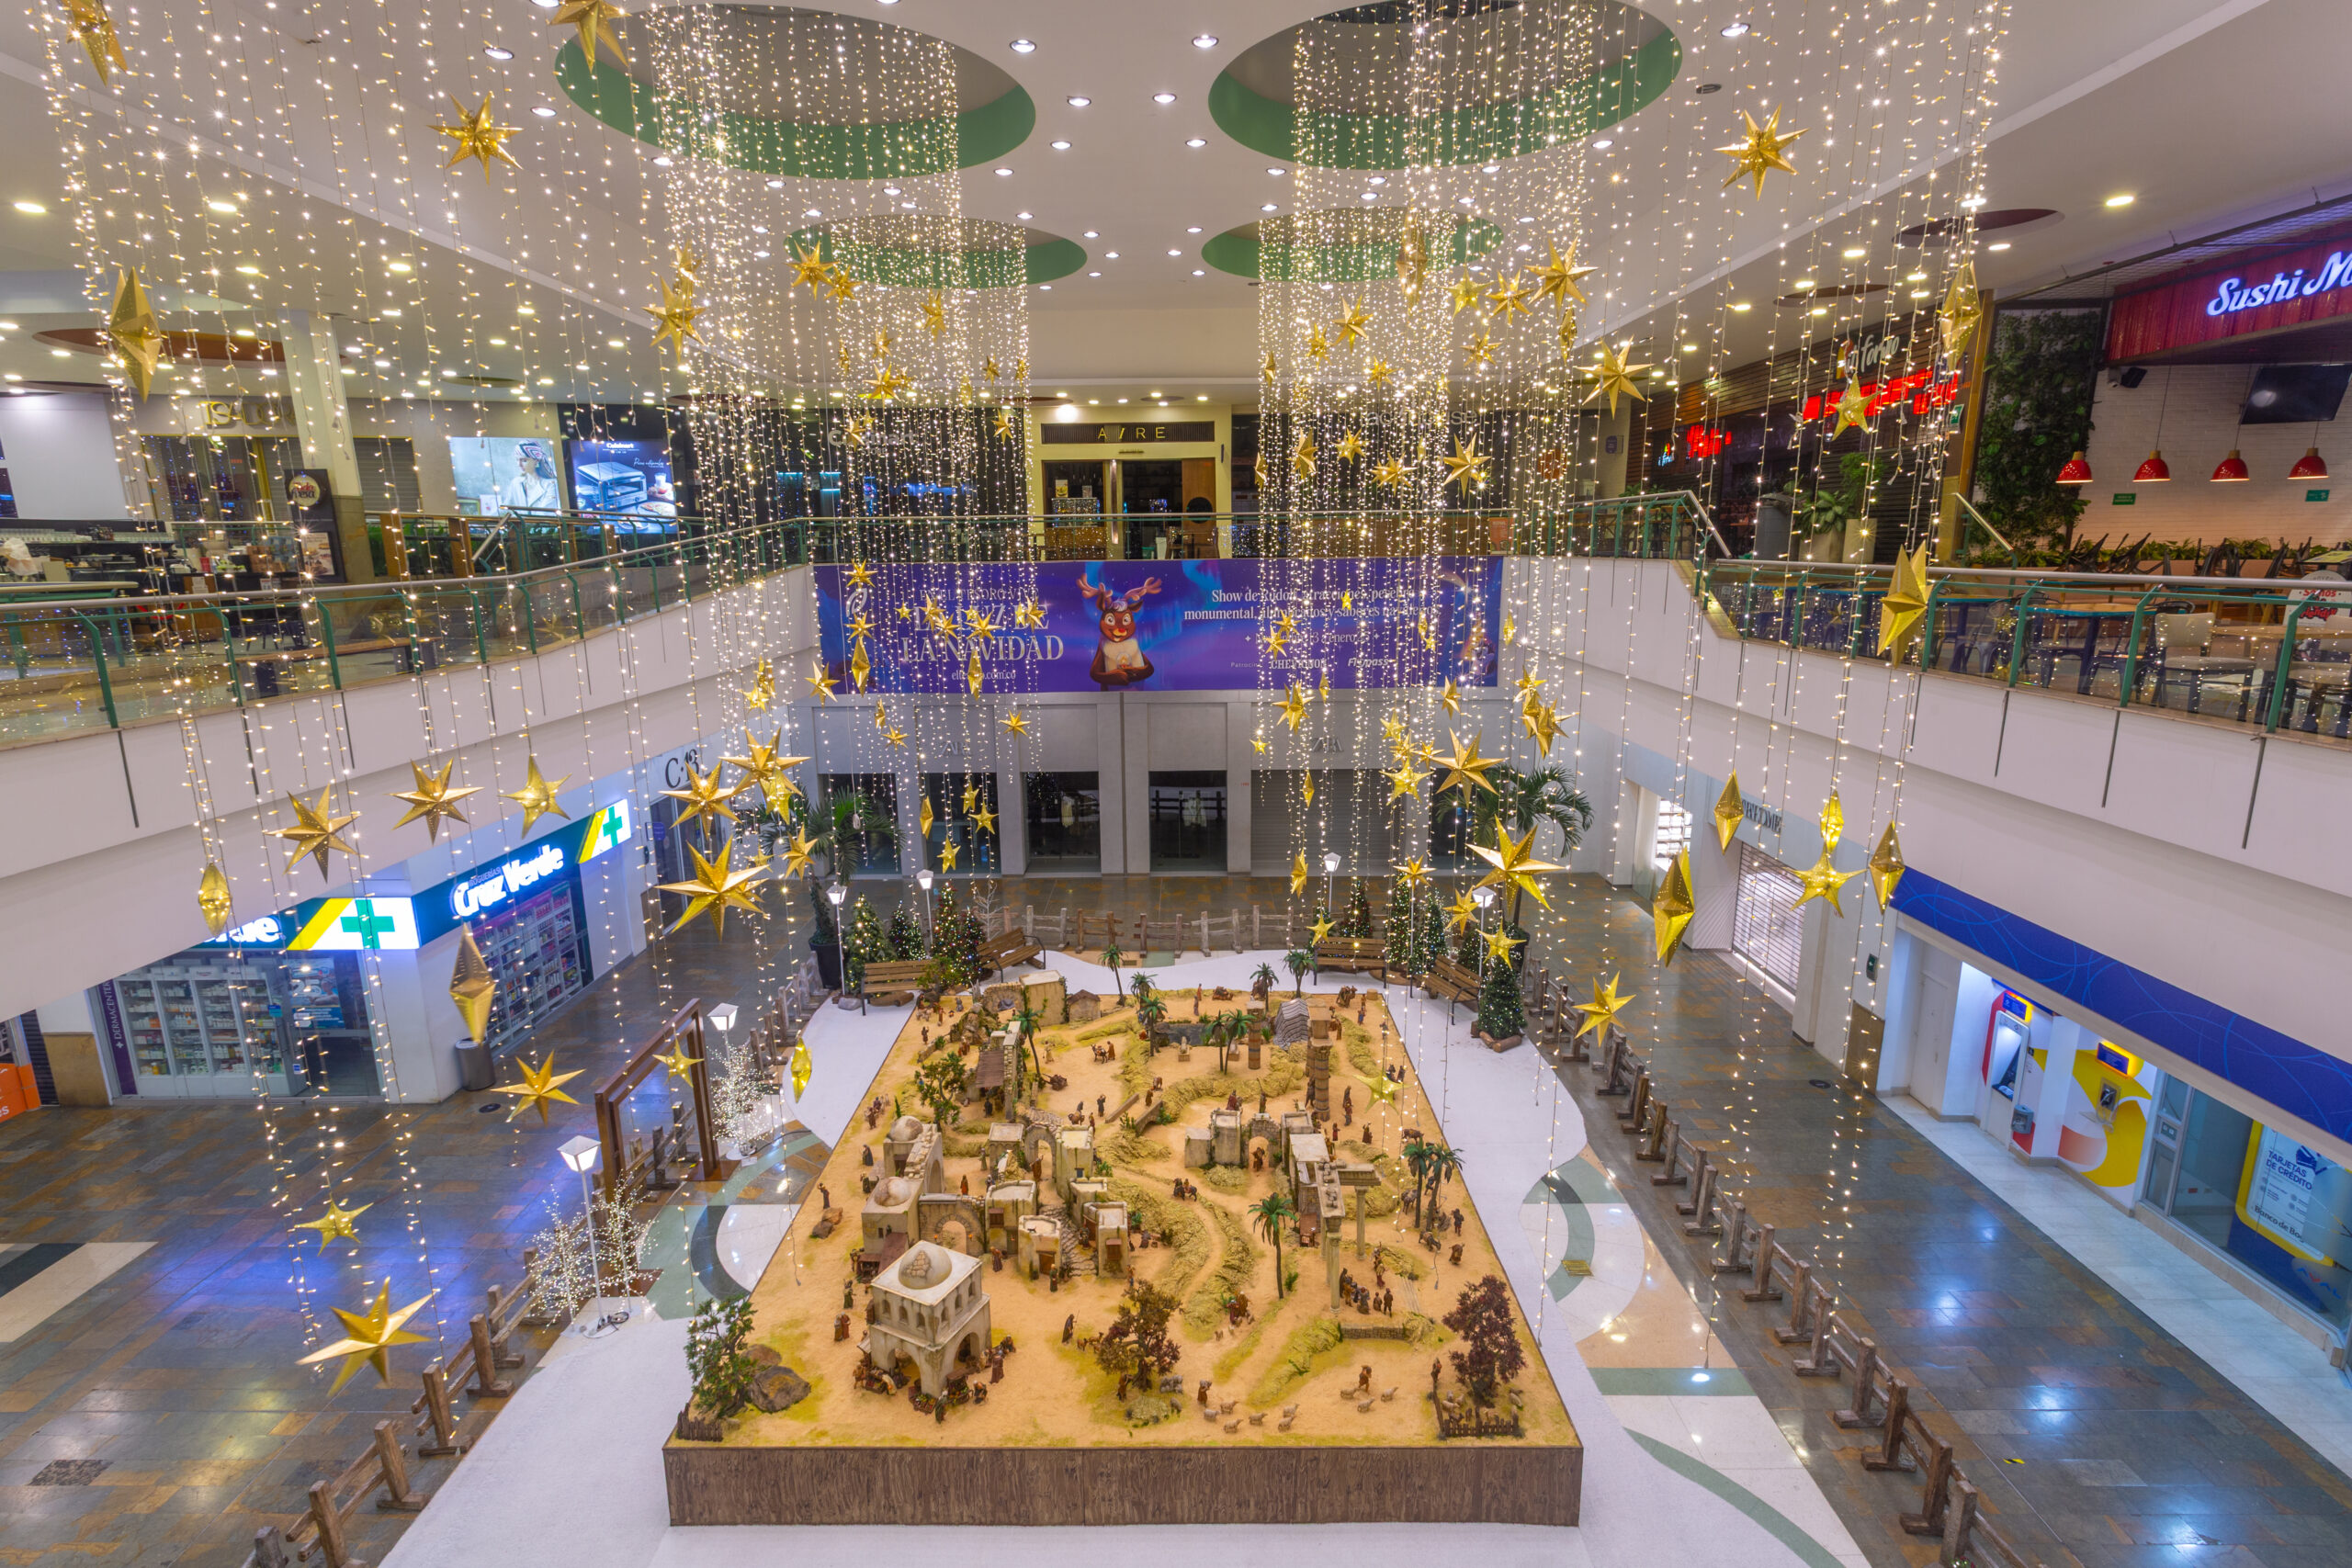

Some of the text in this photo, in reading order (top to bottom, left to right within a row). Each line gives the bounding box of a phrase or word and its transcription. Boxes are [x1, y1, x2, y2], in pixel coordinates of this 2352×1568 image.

[2207, 268, 2304, 316] Sushi
[958, 588, 1005, 601] TESORO
[1212, 589, 1241, 603] Show
[1245, 589, 1258, 602] de
[1184, 605, 1258, 620] monumental,
[900, 635, 1064, 661] LA NAVIDAD
[450, 874, 506, 917] Cruz
[502, 844, 563, 893] Verde
[2266, 1159, 2312, 1191] DE CRÉDITO
[2267, 1150, 2307, 1178] TARJETAS
[2255, 1204, 2278, 1225] Banco
[2278, 1221, 2289, 1230] de
